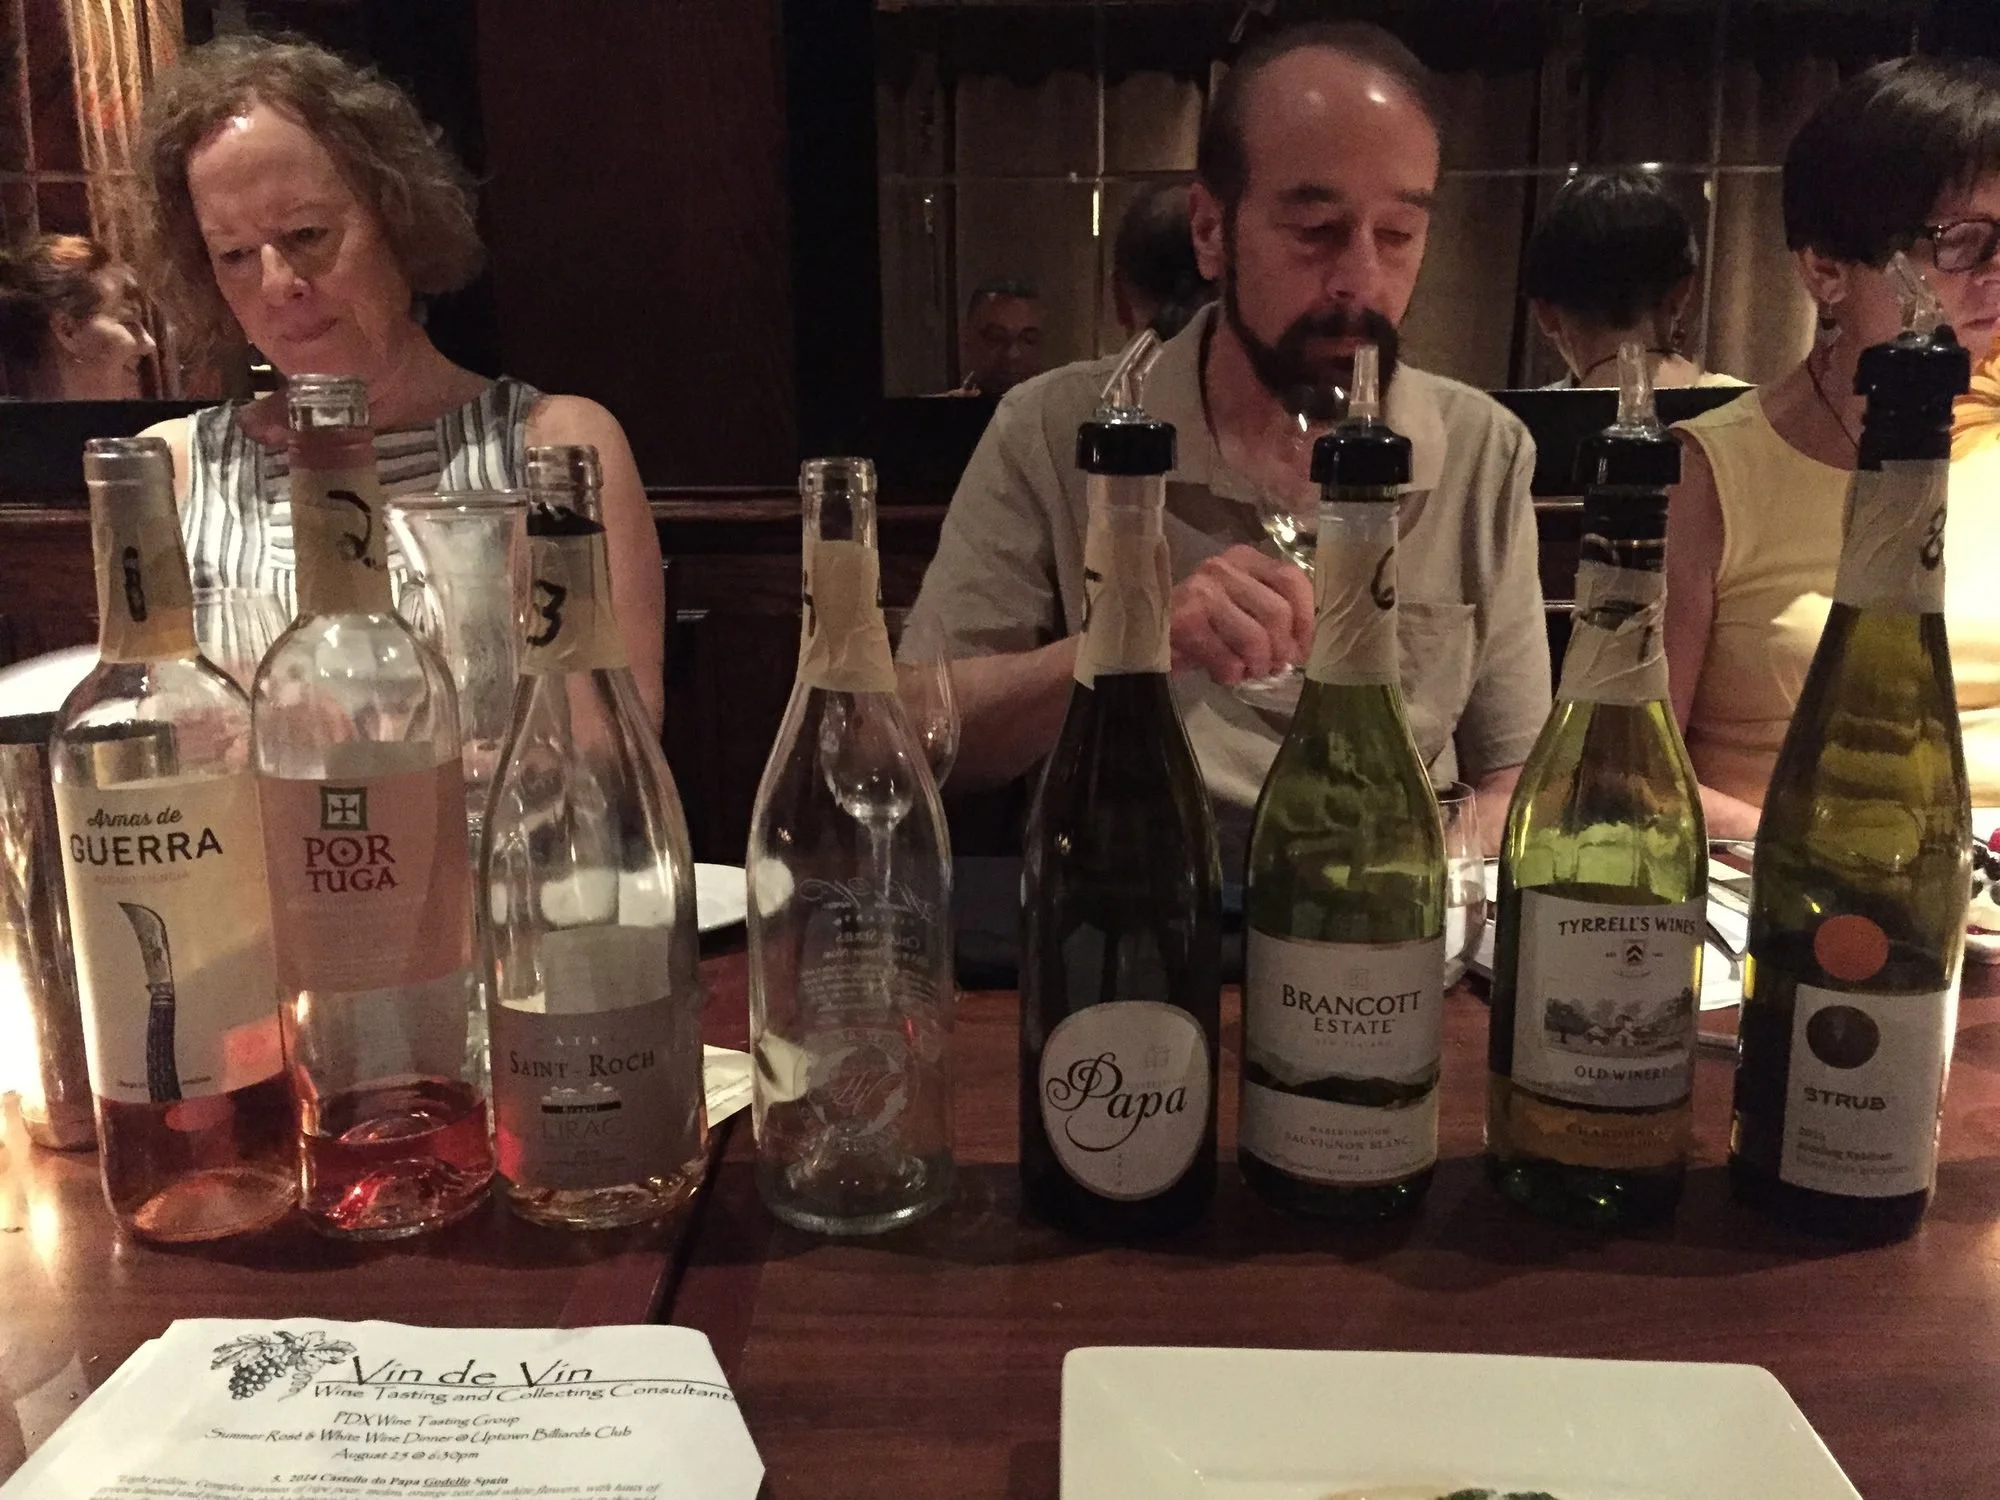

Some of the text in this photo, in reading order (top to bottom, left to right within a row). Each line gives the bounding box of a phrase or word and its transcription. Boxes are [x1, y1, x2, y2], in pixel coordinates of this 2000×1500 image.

[526, 578, 568, 649] 3
[86, 804, 184, 829] Armas de
[69, 827, 224, 866] GUERRA
[302, 833, 397, 868] POR
[304, 866, 400, 894] TUGA
[1558, 915, 1696, 936] TYRRELL'S WINES
[1281, 983, 1422, 1017] BRANCOTT
[1313, 1017, 1393, 1035] ESTATE
[509, 1049, 569, 1079] SAINT
[588, 1049, 656, 1078] ROCH
[1574, 1065, 1608, 1079] OLD
[1045, 1051, 1189, 1152] Papa
[1803, 1086, 1888, 1111] STRUB
[541, 1116, 625, 1140] LIRAC
[352, 1355, 593, 1388] Vin de Vin
[314, 1384, 365, 1399] Wine
[374, 1386, 448, 1405] Tasting
[452, 1385, 493, 1402] and
[496, 1385, 604, 1403] Collecting
[333, 1410, 521, 1430] PDX Wine Tasting Group
[205, 1427, 266, 1441] Summer
[319, 1428, 362, 1443] White
[364, 1431, 401, 1444] Wine
[402, 1431, 454, 1445] Dinner
[469, 1430, 530, 1446] Uptown
[531, 1426, 592, 1442] Billiards
[594, 1424, 634, 1440] Club
[331, 1447, 389, 1463] August
[388, 1476, 421, 1488] Papa
[473, 1475, 510, 1487] Spain
